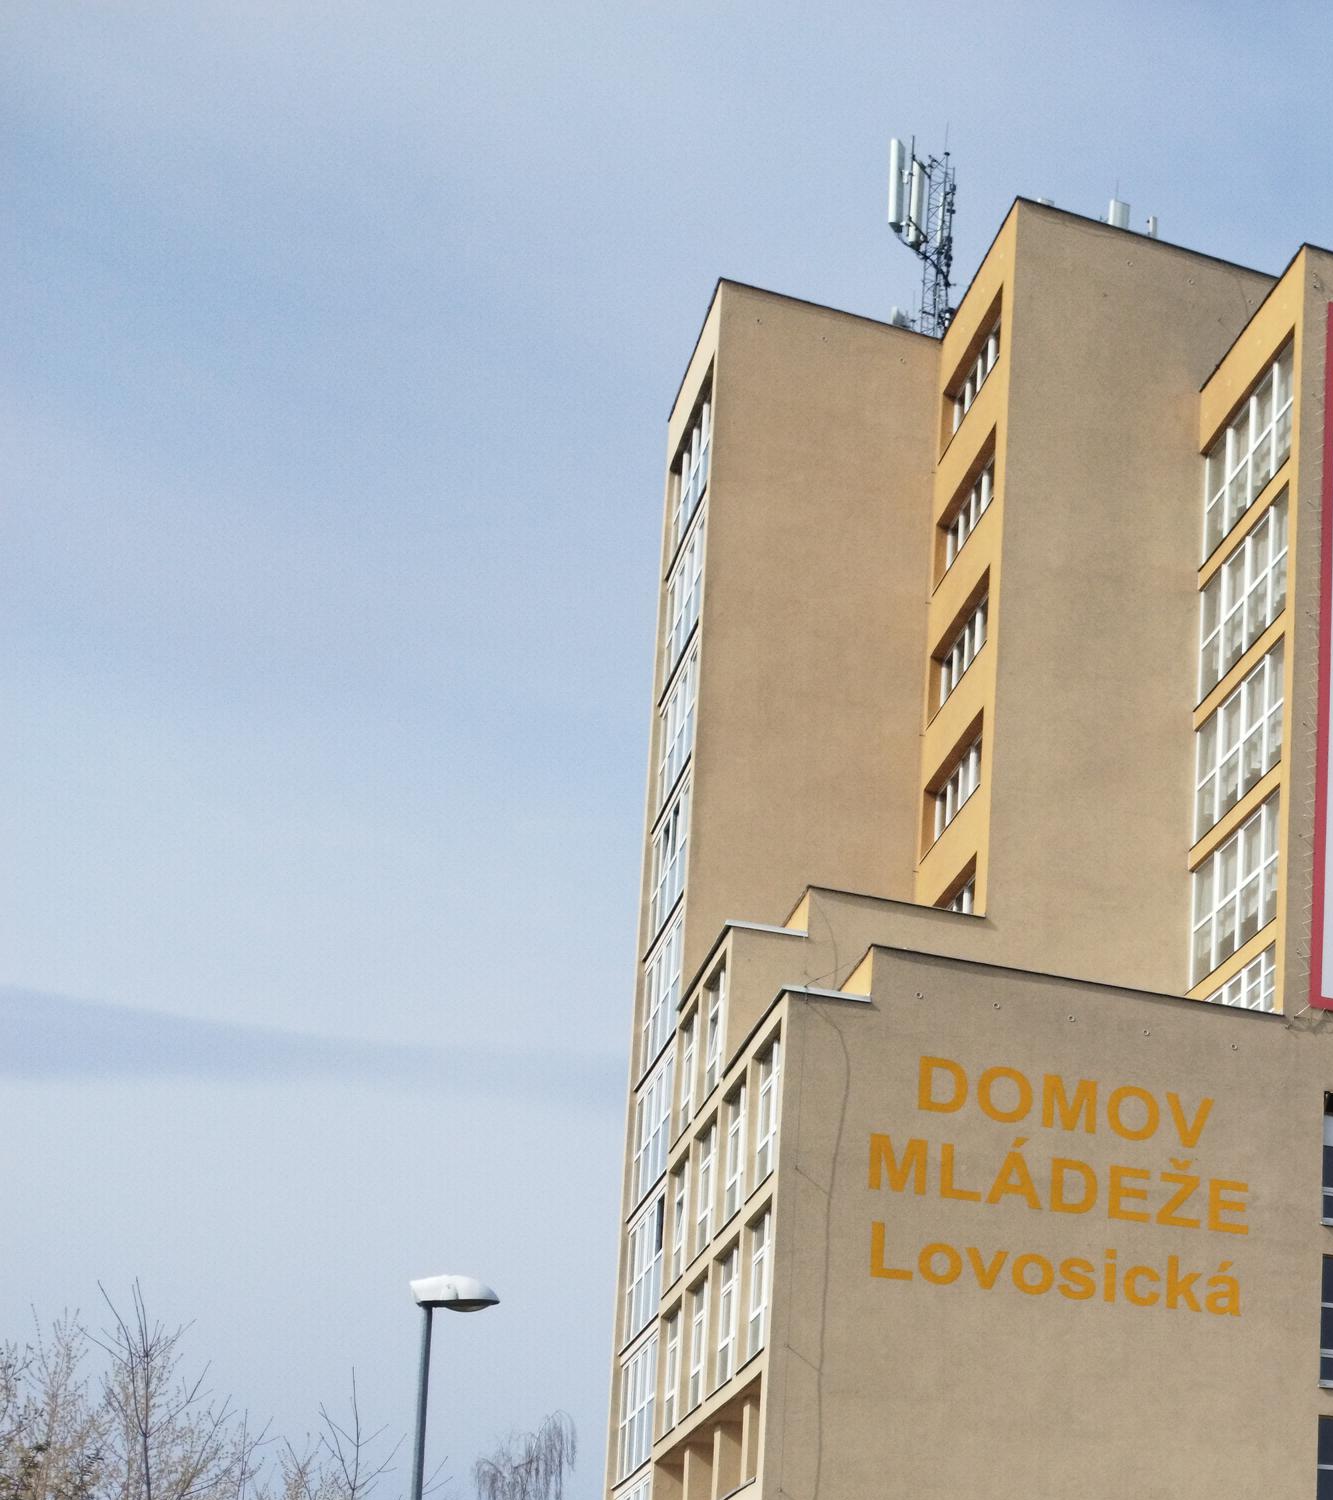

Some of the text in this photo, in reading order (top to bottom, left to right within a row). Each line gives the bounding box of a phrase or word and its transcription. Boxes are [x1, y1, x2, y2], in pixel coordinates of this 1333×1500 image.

[917, 1055, 1215, 1149] DOMOV
[867, 1132, 1250, 1236] MLÁDEŽE
[869, 1220, 1242, 1317] Lovosická
